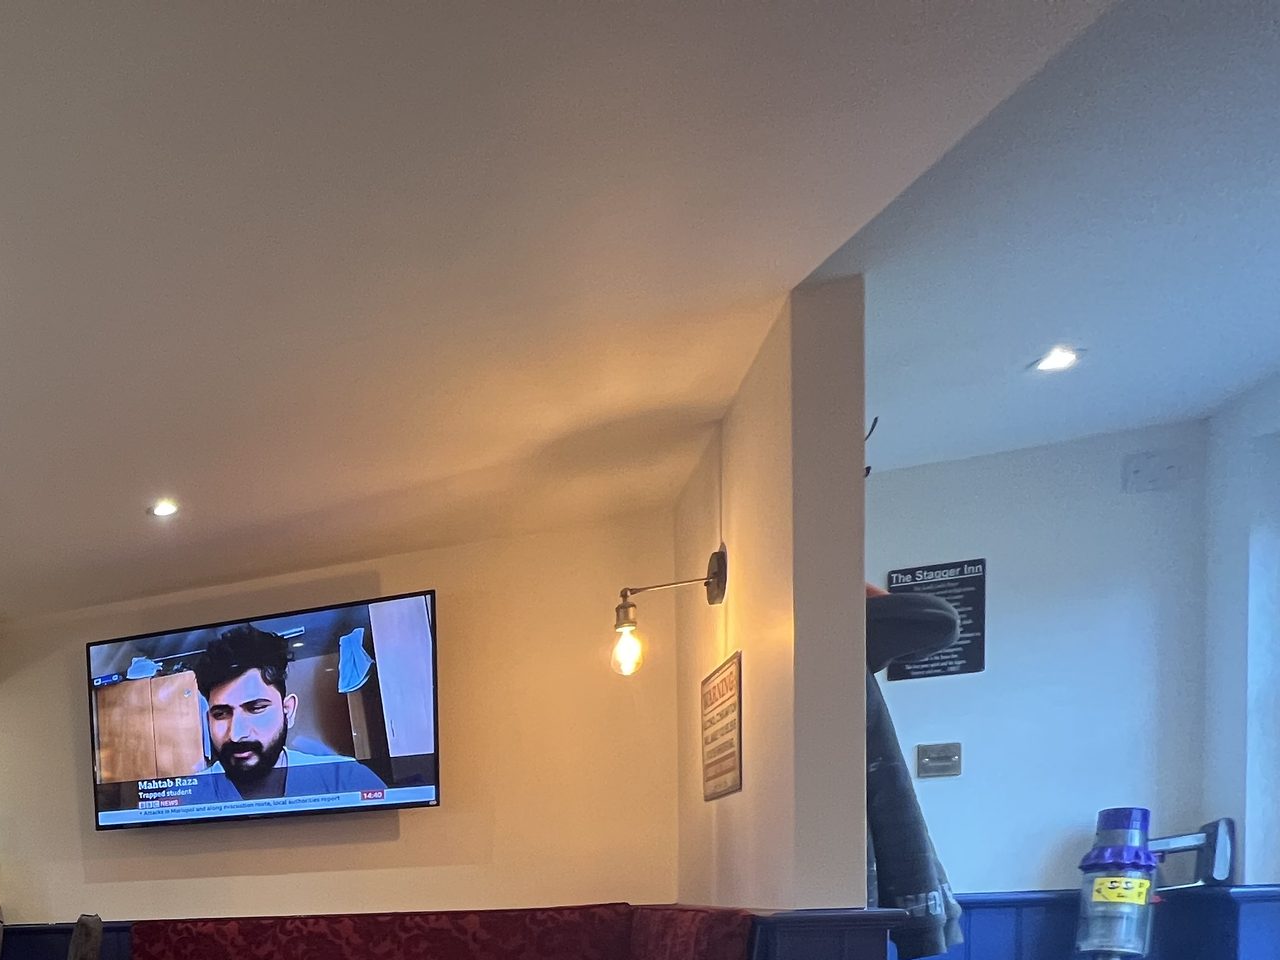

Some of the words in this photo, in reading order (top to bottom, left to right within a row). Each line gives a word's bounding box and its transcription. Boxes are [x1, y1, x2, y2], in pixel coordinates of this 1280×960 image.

[891, 573, 912, 584] The
[915, 567, 961, 580] Stagger
[963, 564, 983, 574] Inn
[138, 779, 173, 790] Mahtab
[175, 778, 198, 787] Raza
[138, 790, 166, 799] Trapped
[167, 788, 192, 797] student
[363, 791, 382, 799] 14:40
